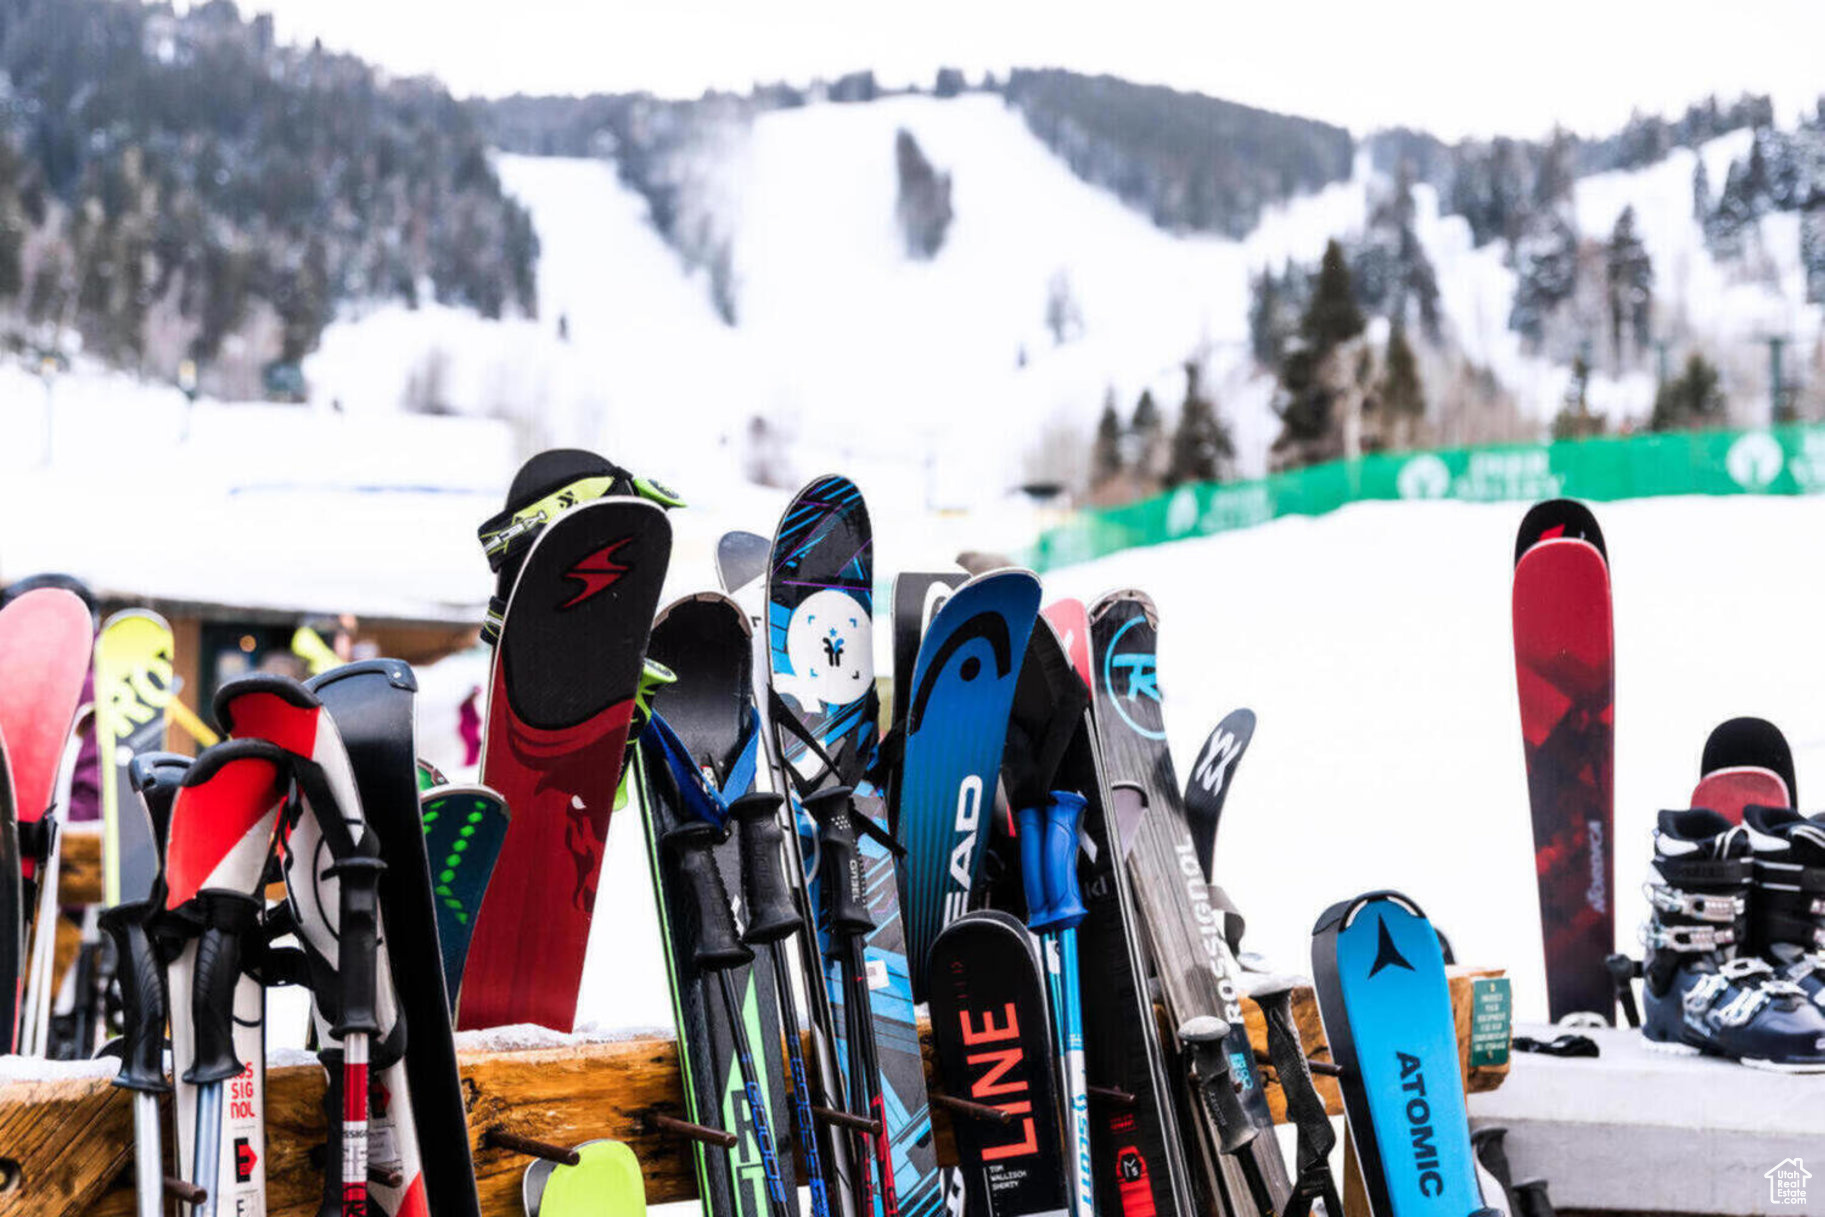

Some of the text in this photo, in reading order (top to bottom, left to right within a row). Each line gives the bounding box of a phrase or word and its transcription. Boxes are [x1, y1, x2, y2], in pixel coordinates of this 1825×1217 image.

[942, 774, 983, 931] EAD
[959, 1002, 1038, 1161] LINE
[1395, 1051, 1444, 1198] ATOMIC
[1079, 1117, 1093, 1207] SCOTT
